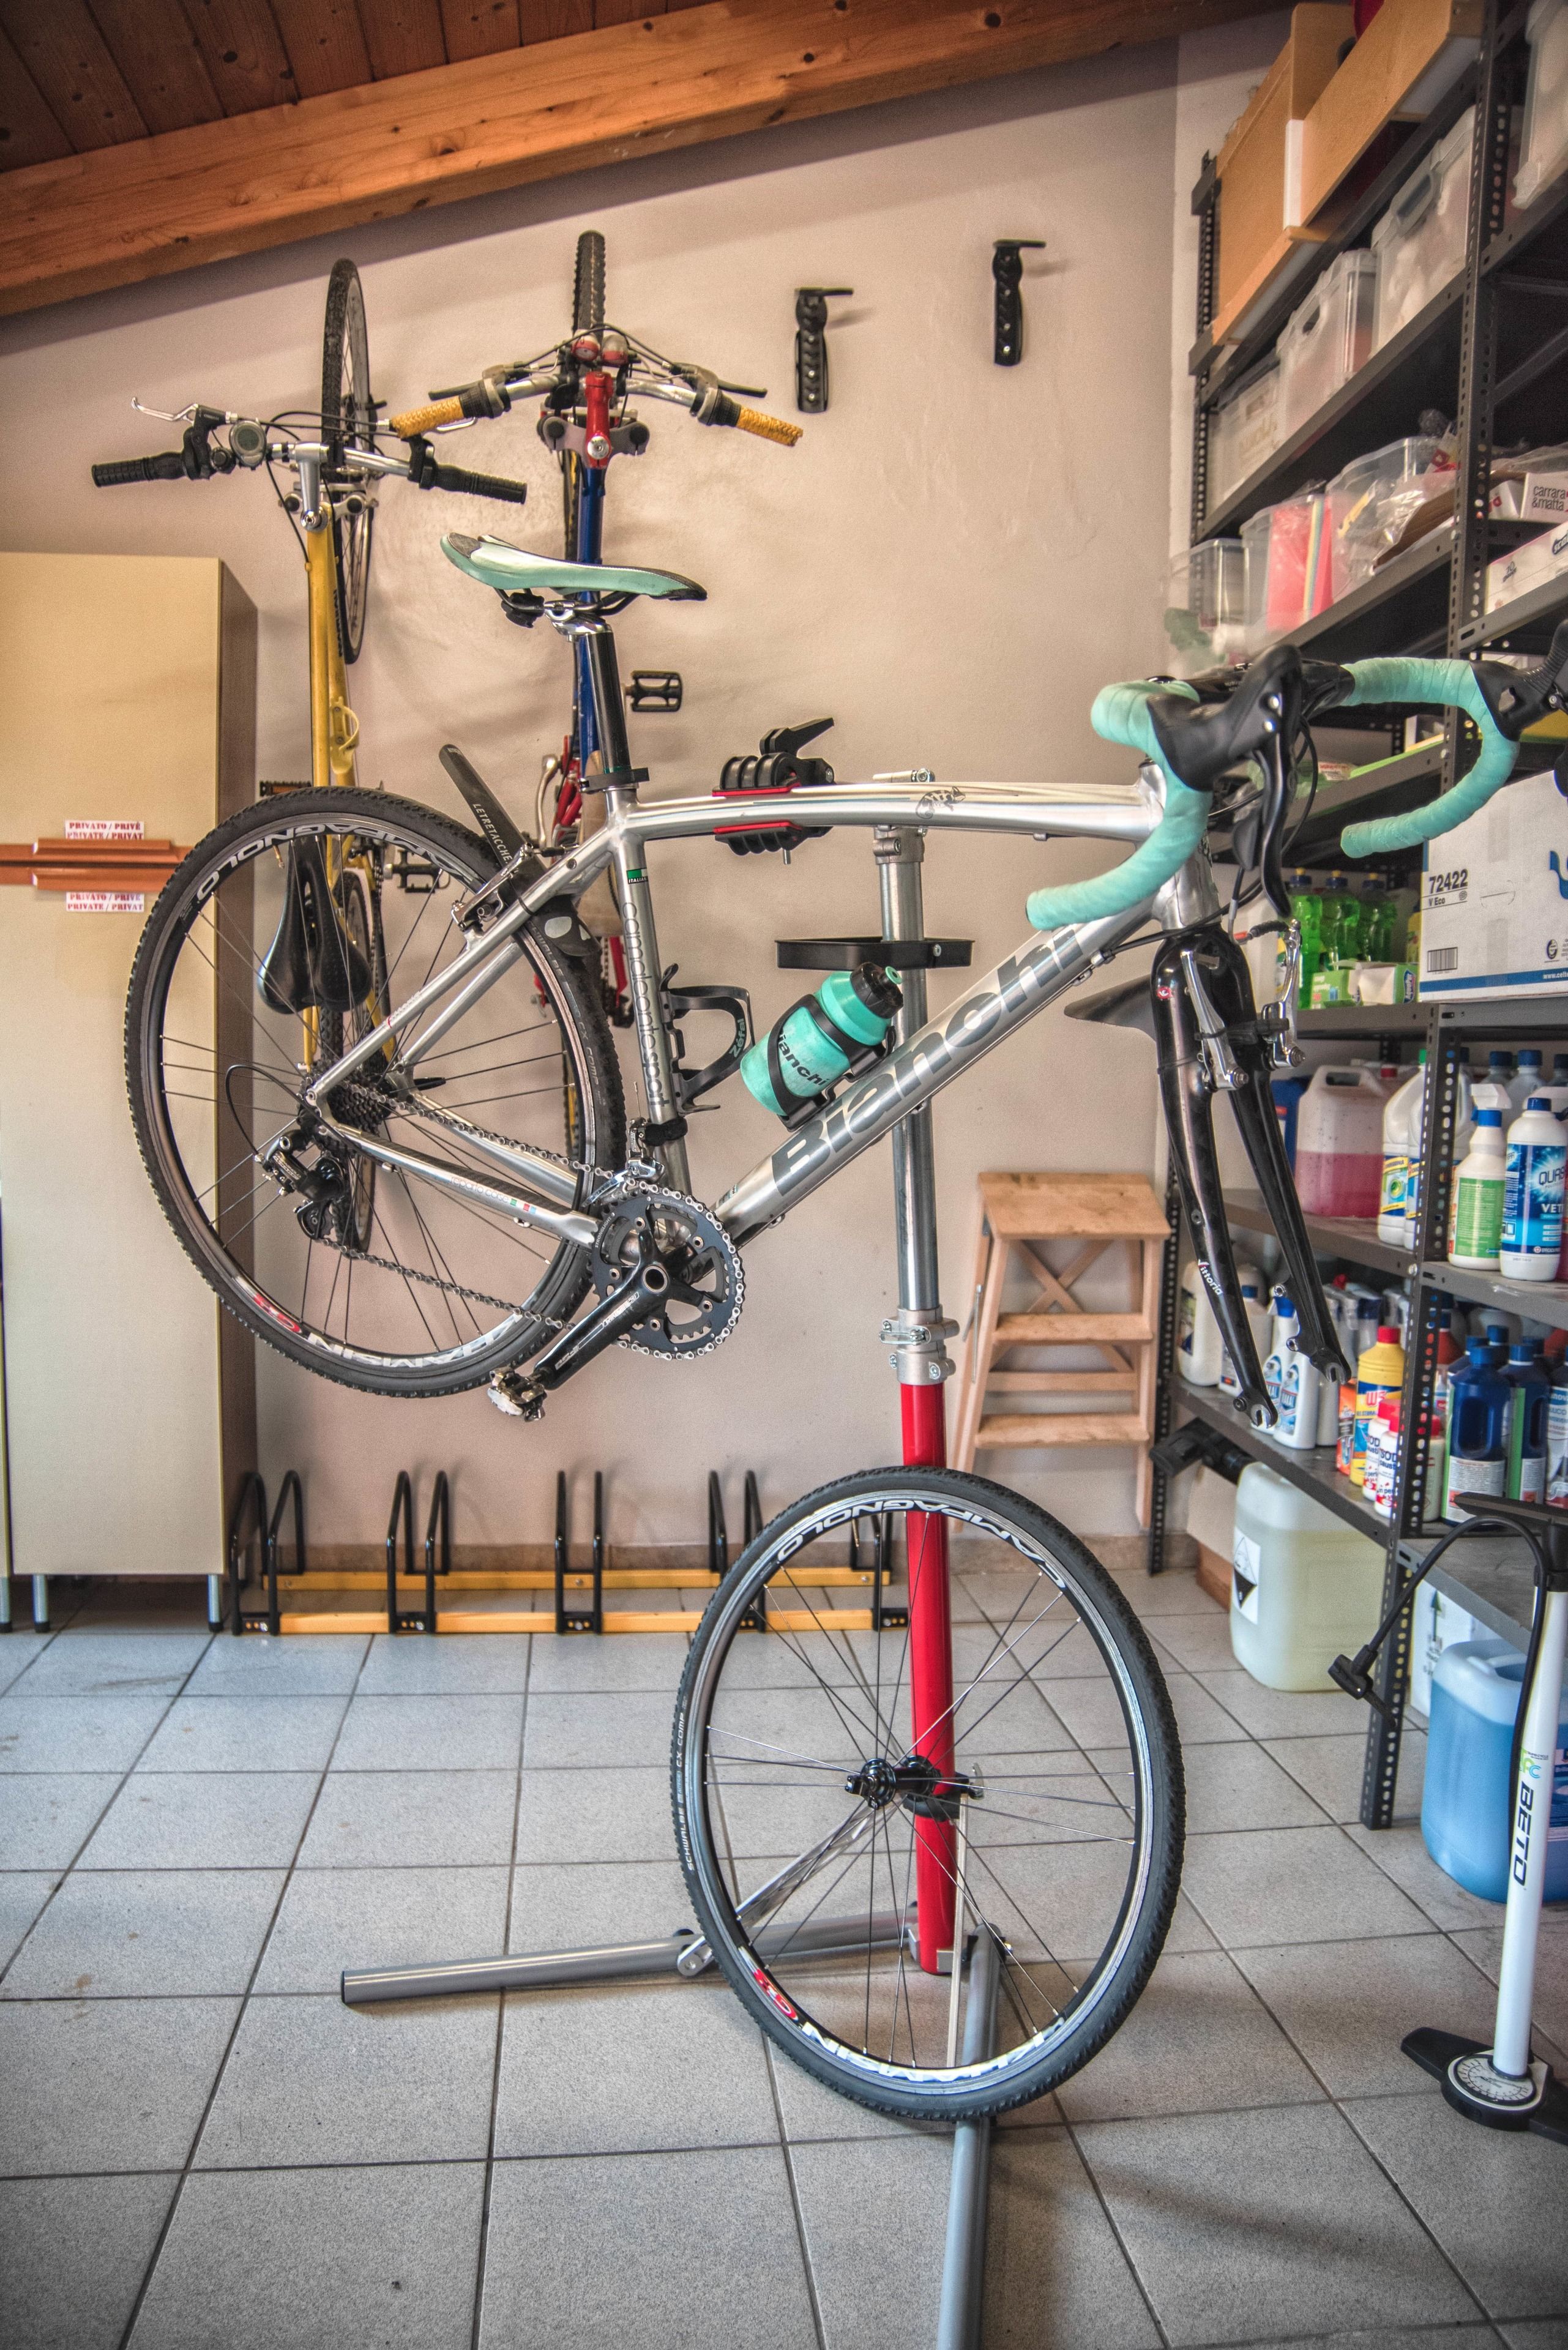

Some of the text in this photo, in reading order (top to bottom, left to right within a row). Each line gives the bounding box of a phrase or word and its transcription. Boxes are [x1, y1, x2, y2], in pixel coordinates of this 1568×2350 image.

[1532, 498, 1564, 511] &matta
[1533, 486, 1566, 499] carrara
[114, 821, 141, 830] PRIVÉ
[197, 823, 476, 901] CAMPAGNOLO
[1429, 868, 1468, 893] 72422
[1435, 897, 1446, 906] Eco
[529, 920, 566, 978] CHWALBE
[584, 1045, 600, 1086] COMP
[621, 901, 670, 1106] camaleonte sport
[729, 1018, 745, 1058] Zéfal
[772, 927, 1084, 1196] Bianchi
[779, 1032, 831, 1087] ianchi
[485, 1190, 509, 1203] corse
[595, 1217, 612, 1248] STRONGLIGHT
[1198, 1259, 1223, 1296] Vittoria
[307, 1312, 523, 1368] KHAMSIN
[777, 1500, 1066, 1588] CAMPAGNOLO
[678, 1712, 686, 1746] COMP
[676, 1752, 682, 1767] CX
[679, 1807, 695, 1871] SCHWALBE
[1514, 1780, 1534, 1887] BETO
[802, 2017, 1064, 2081] KHAMSIN
